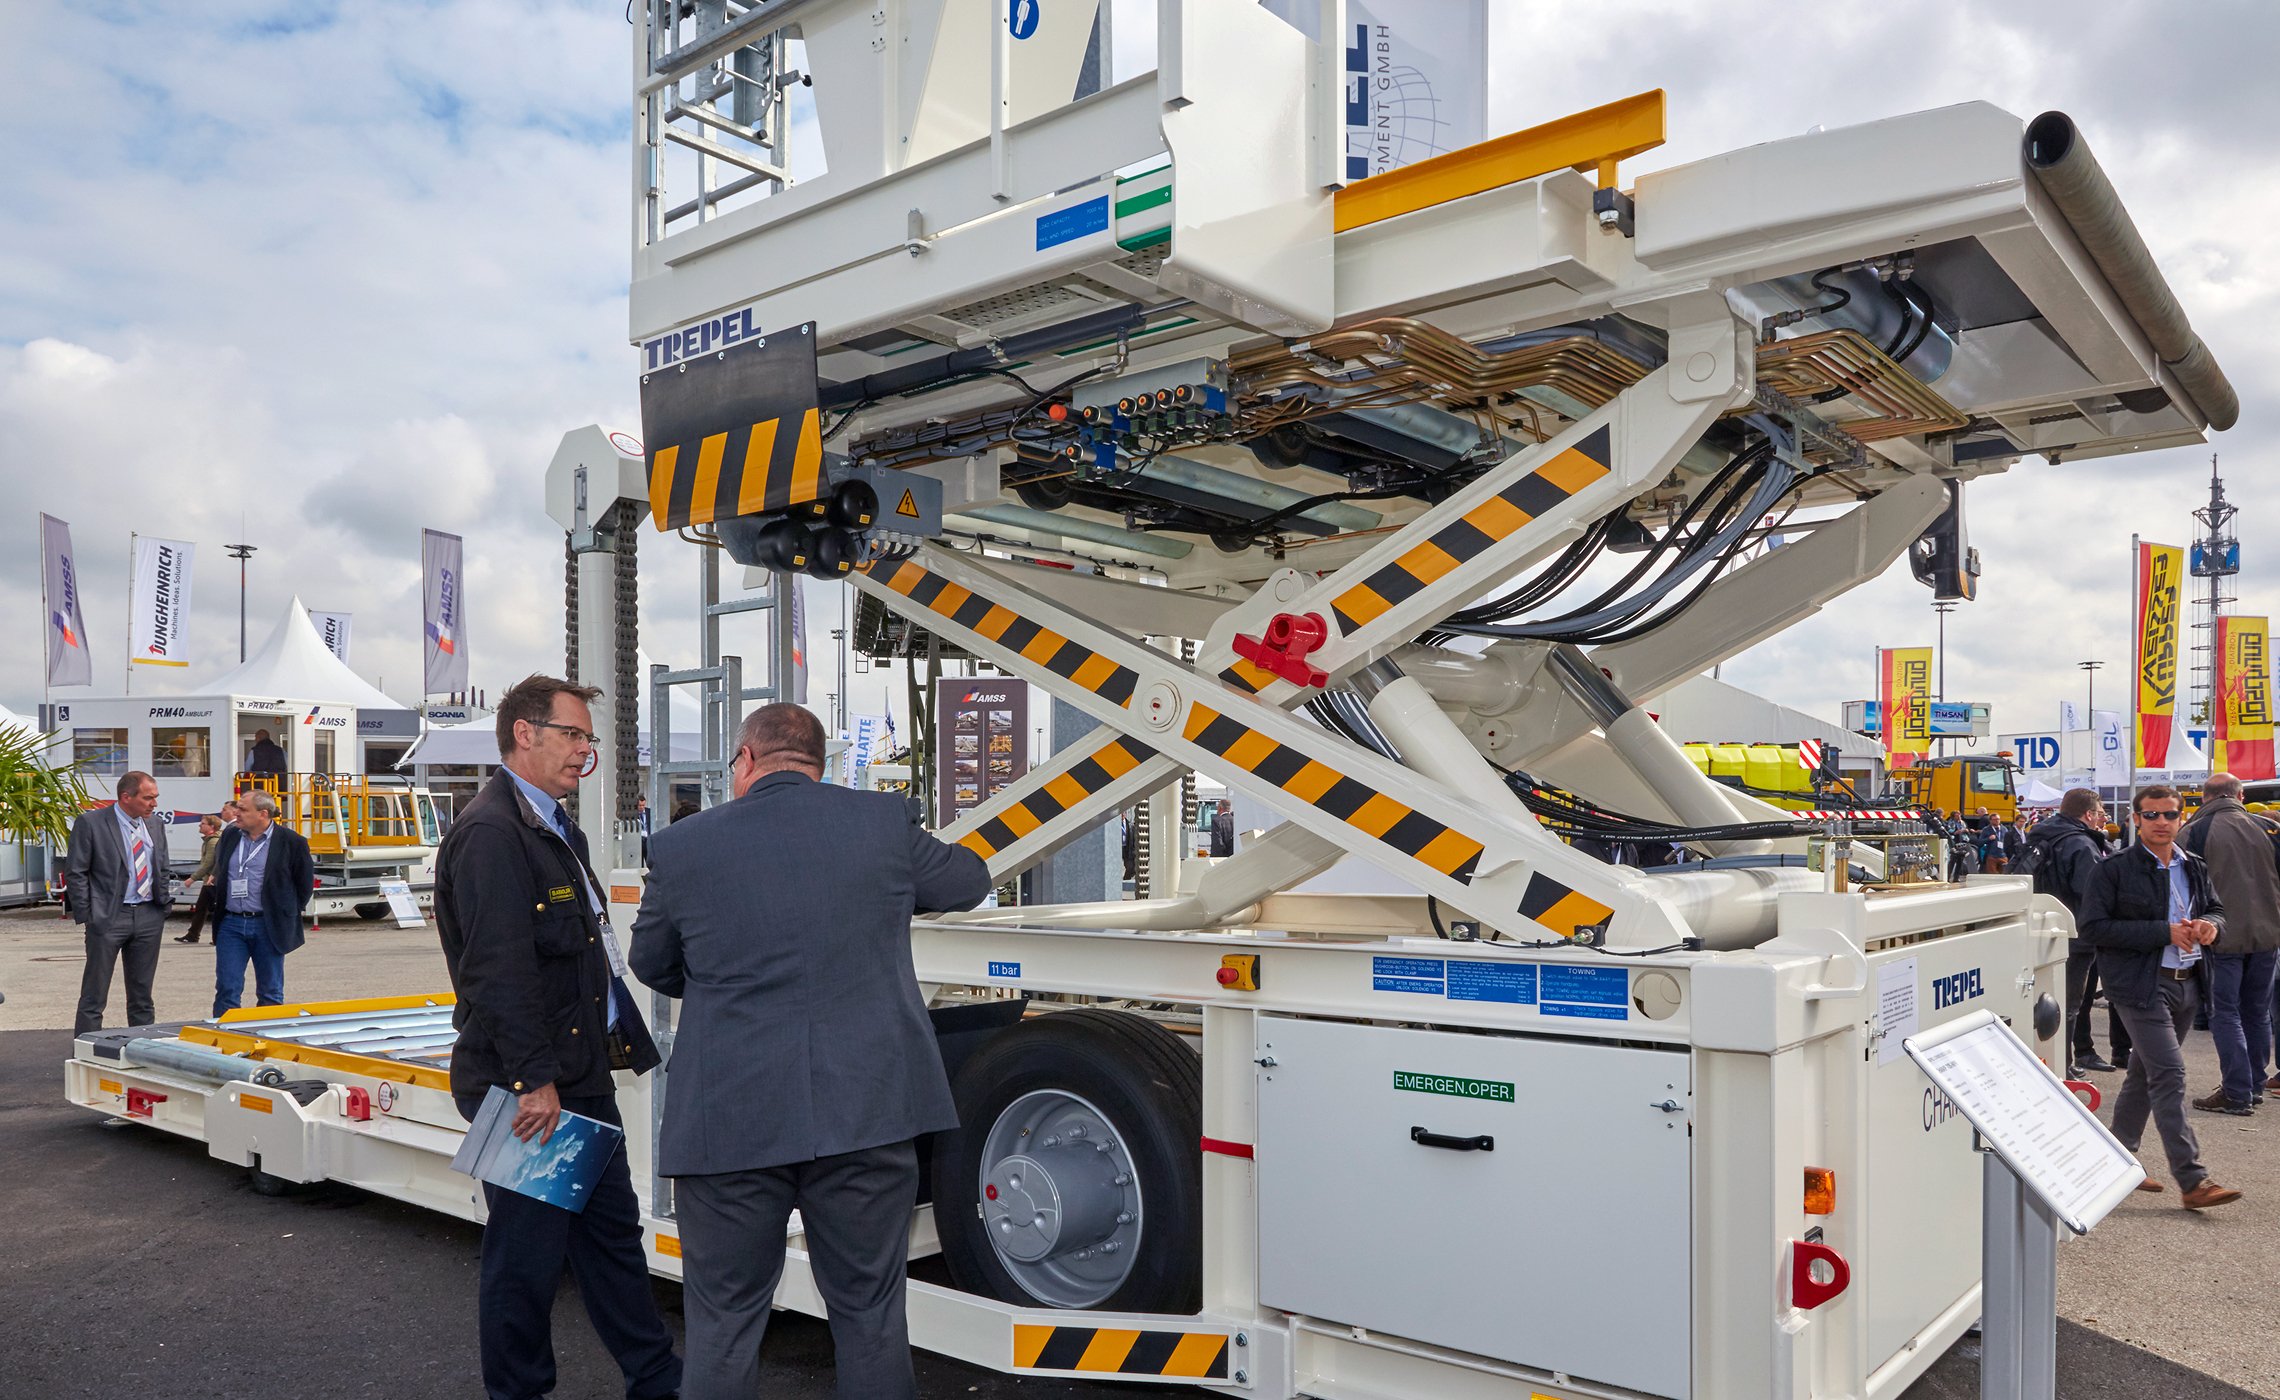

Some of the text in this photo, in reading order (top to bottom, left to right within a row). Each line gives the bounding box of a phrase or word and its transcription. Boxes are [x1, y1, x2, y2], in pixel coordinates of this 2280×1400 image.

[1377, 25, 1390, 90] GMBH
[644, 307, 762, 370] TREPEL
[173, 551, 183, 584] Solutions.
[61, 554, 73, 617] AMSS
[441, 567, 454, 627] AMSS
[153, 545, 173, 656] JUNGHEINRICH
[325, 617, 336, 652] NRICH
[149, 706, 185, 718] PRM40
[247, 702, 274, 710] PRM40
[976, 694, 1006, 702] AMSS
[318, 717, 347, 727] AMSS
[428, 711, 466, 719] SCANIA
[2014, 737, 2060, 769] TLD
[153, 810, 174, 824] SS
[992, 964, 1018, 976] 11 bar
[1568, 968, 1596, 976] TOWING
[1932, 968, 1984, 1011] TREPEL
[1395, 1074, 1513, 1100] EMERGEN.OPER.
